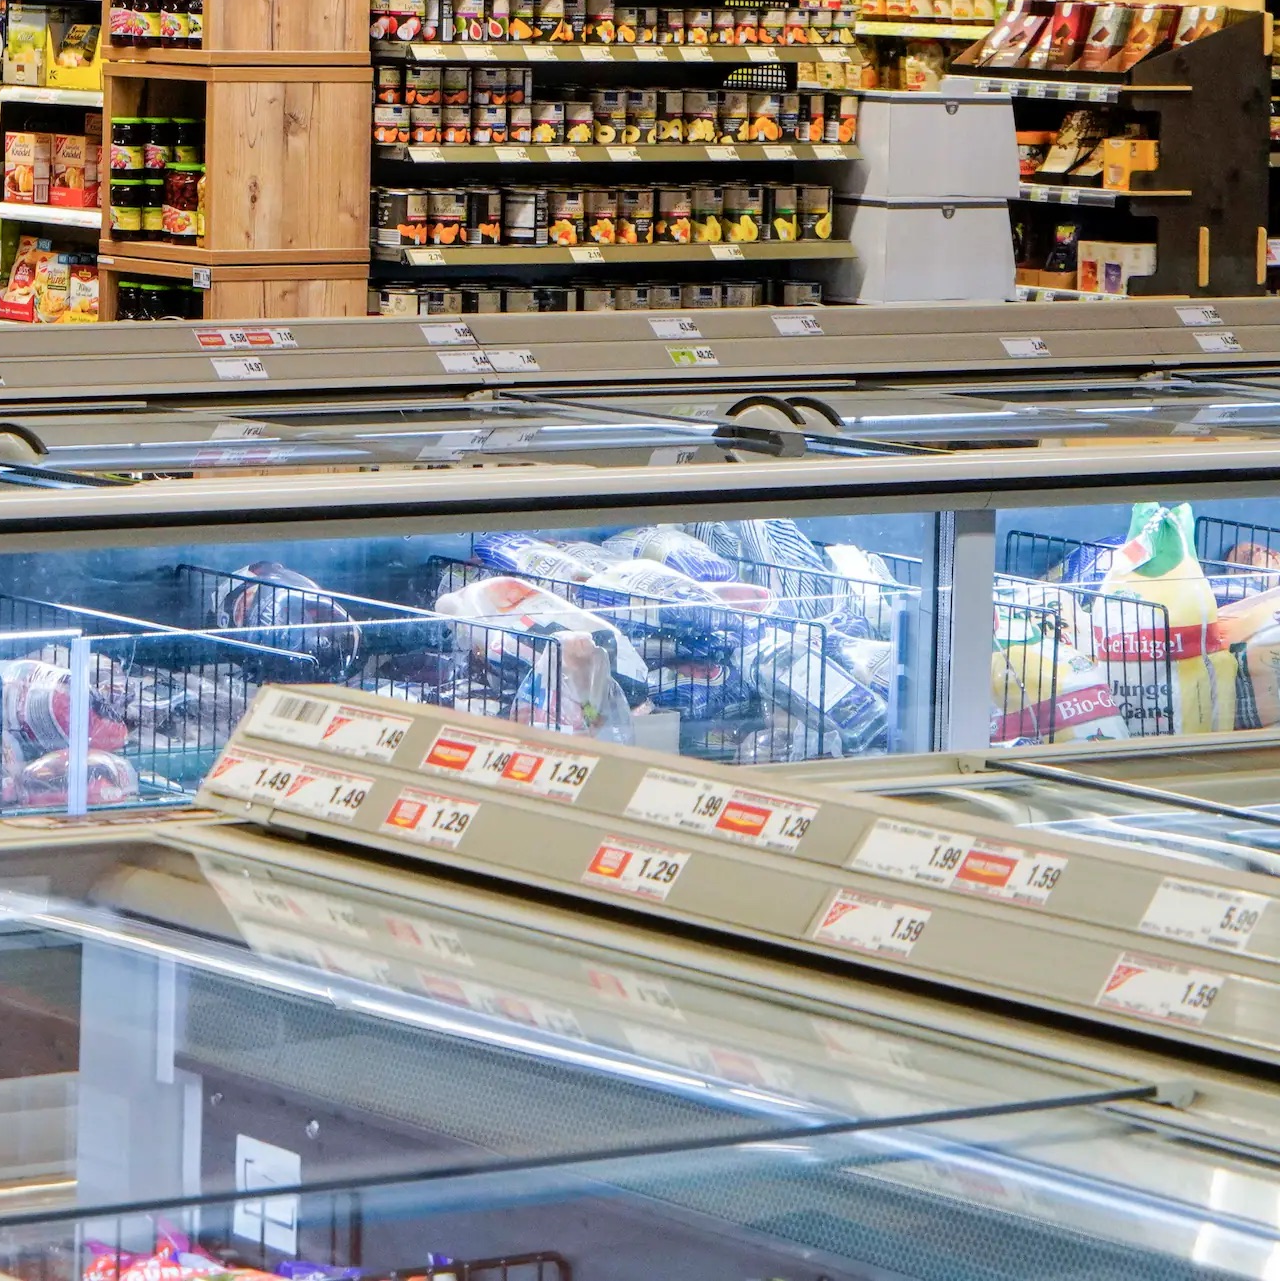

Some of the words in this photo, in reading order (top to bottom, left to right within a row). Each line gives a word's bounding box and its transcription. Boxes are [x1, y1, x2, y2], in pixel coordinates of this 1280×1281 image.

[11, 148, 31, 157] Knödel
[61, 150, 81, 160] Knödel
[47, 271, 66, 286] Püree
[243, 362, 265, 374] 14.97
[1109, 679, 1171, 699] Junge
[1119, 702, 1174, 721] Gans
[376, 726, 405, 750] 1.49
[482, 749, 512, 772] 1.49
[255, 767, 291, 791] 1.49
[550, 761, 589, 786] 1.29
[329, 785, 366, 809] 1.49
[692, 794, 724, 818] 1.99
[431, 808, 470, 834] 1.29
[779, 814, 811, 839] 1.29
[639, 857, 680, 883] 1.29
[928, 845, 962, 871] 1.99
[1026, 864, 1061, 890] 1.59
[890, 916, 925, 942] 1.59
[1220, 906, 1260, 935] 5.99
[1181, 981, 1219, 1008] 1.59
